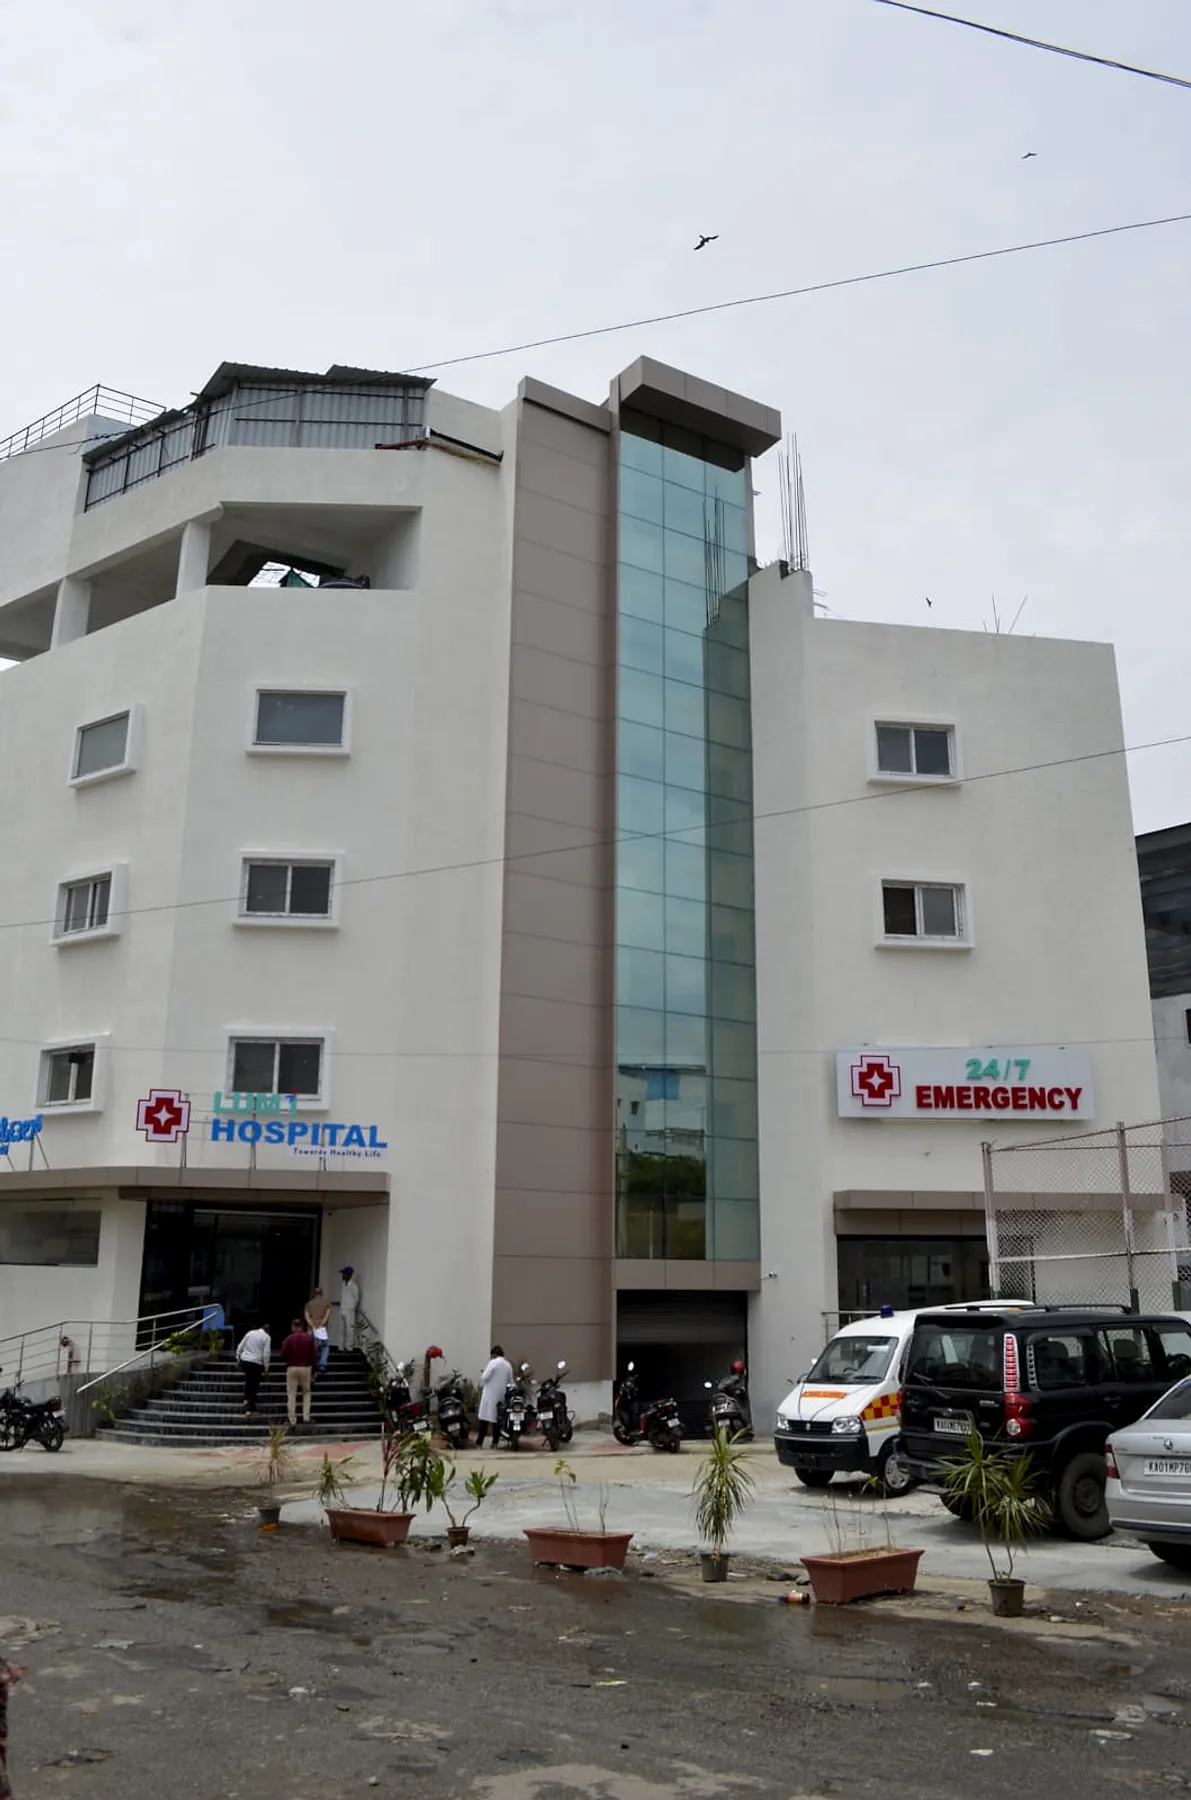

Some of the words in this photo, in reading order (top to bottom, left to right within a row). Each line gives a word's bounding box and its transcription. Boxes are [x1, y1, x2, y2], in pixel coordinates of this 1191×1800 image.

[966, 1058, 1030, 1080] 24/7
[916, 1085, 1082, 1110] EMERGENCY
[211, 1118, 388, 1149] HOSPITAL
[293, 1147, 327, 1157] Towards
[330, 1148, 362, 1158] Healthy
[365, 1150, 382, 1158] Life
